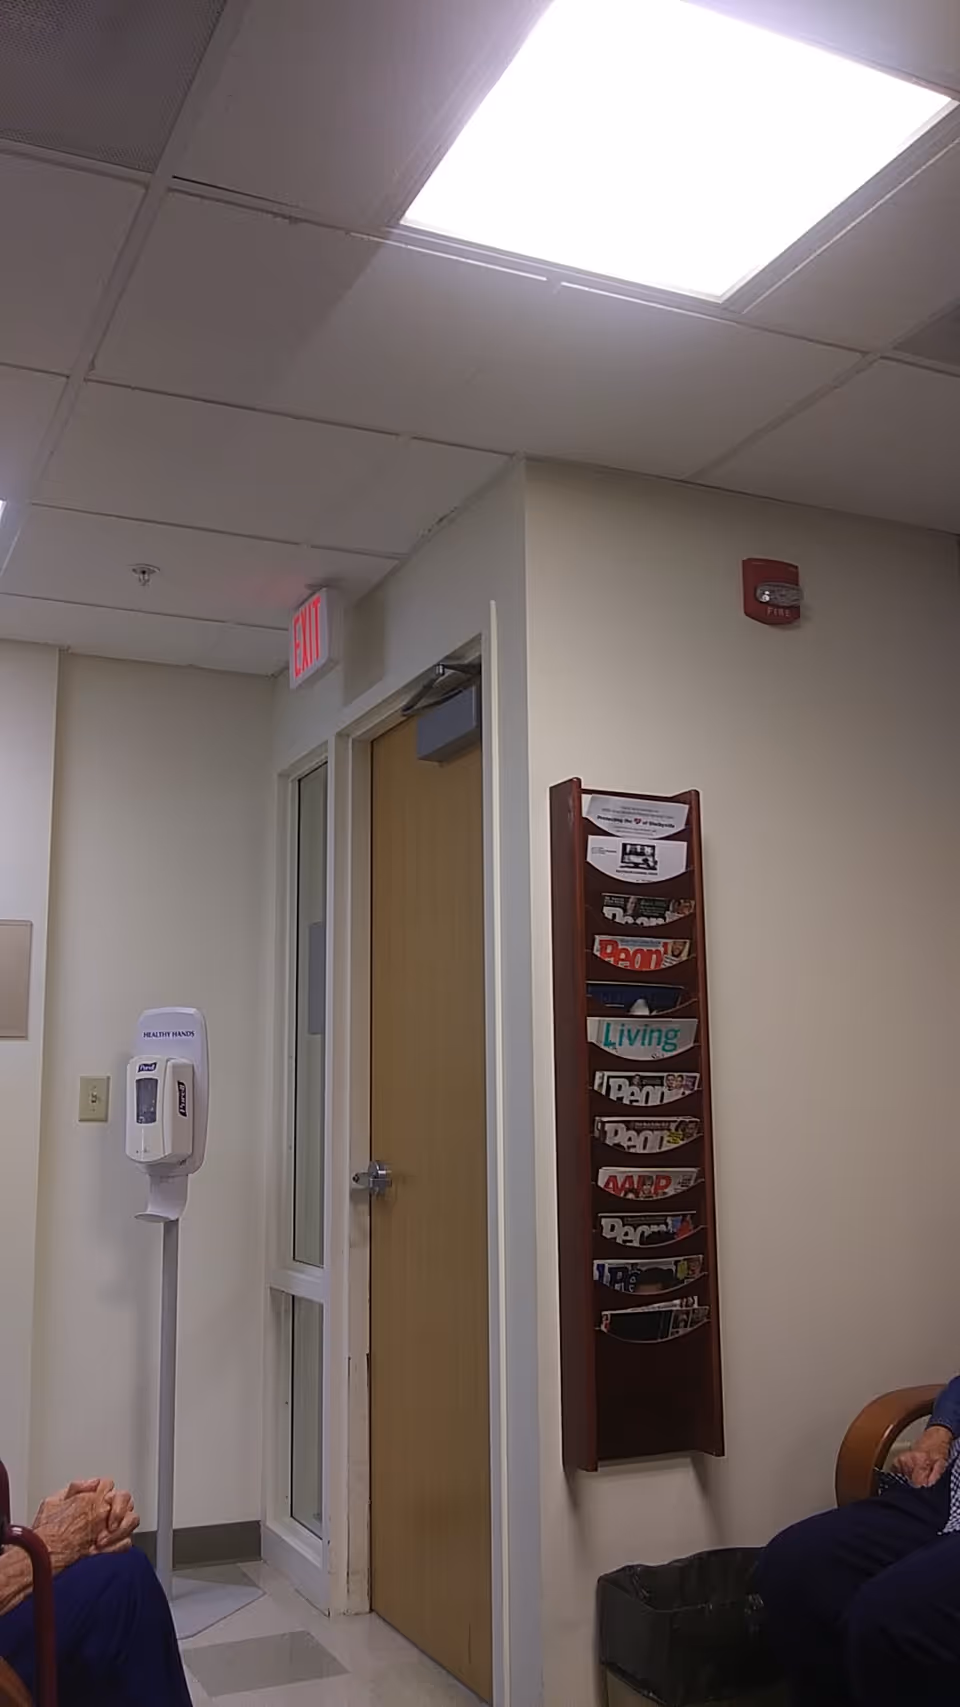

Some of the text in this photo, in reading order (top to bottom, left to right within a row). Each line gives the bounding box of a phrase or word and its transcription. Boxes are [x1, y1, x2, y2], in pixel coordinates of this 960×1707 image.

[767, 606, 790, 617] FIRE
[292, 595, 321, 678] EXIT
[172, 1030, 195, 1038] HANDS
[603, 1022, 681, 1053] Living
